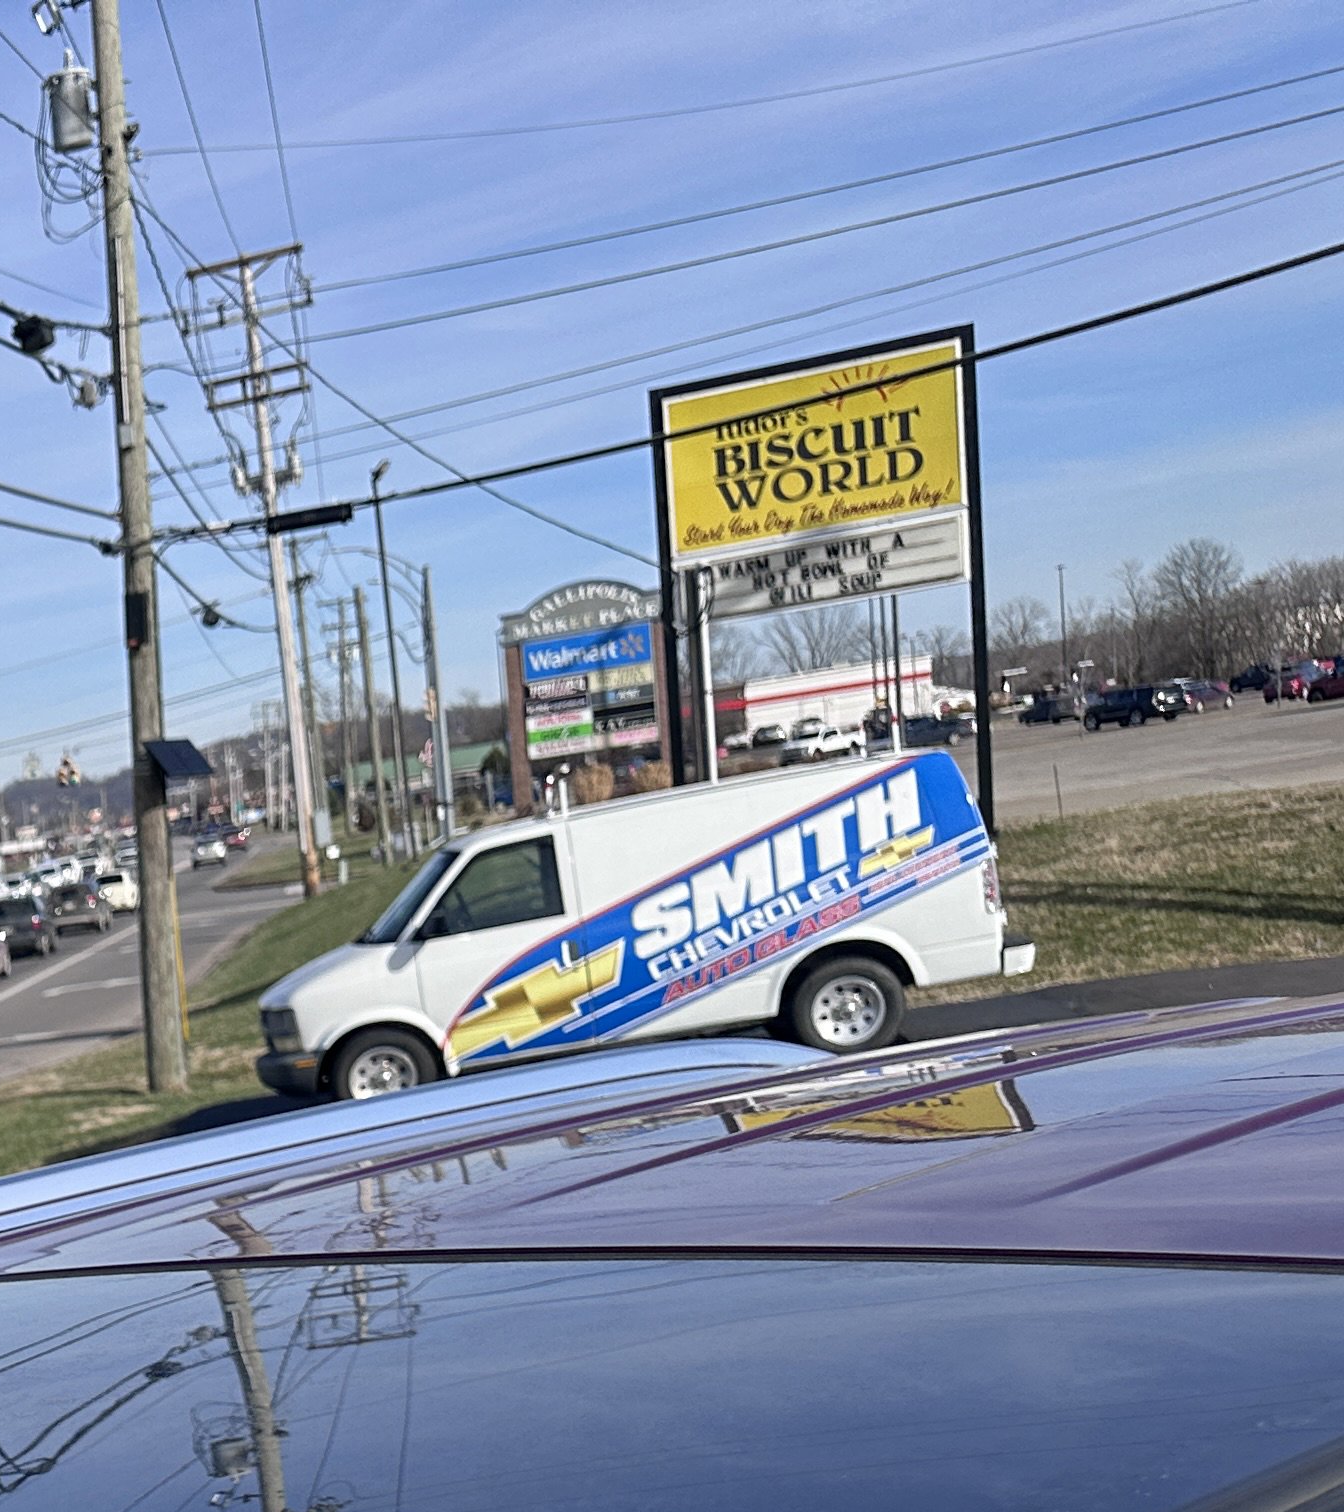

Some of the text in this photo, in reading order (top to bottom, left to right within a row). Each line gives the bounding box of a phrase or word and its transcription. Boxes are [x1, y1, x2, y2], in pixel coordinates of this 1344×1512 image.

[713, 405, 920, 478] BISCUIT
[714, 447, 924, 513] WORLD
[718, 531, 905, 579] WARM UP WITH A
[839, 572, 883, 595] SOUP
[867, 551, 890, 571] OF
[528, 640, 619, 672] Walmart
[631, 767, 921, 960] SMITH
[647, 864, 852, 981] CHEVROLET
[664, 894, 861, 1002] AUTO GLASS
